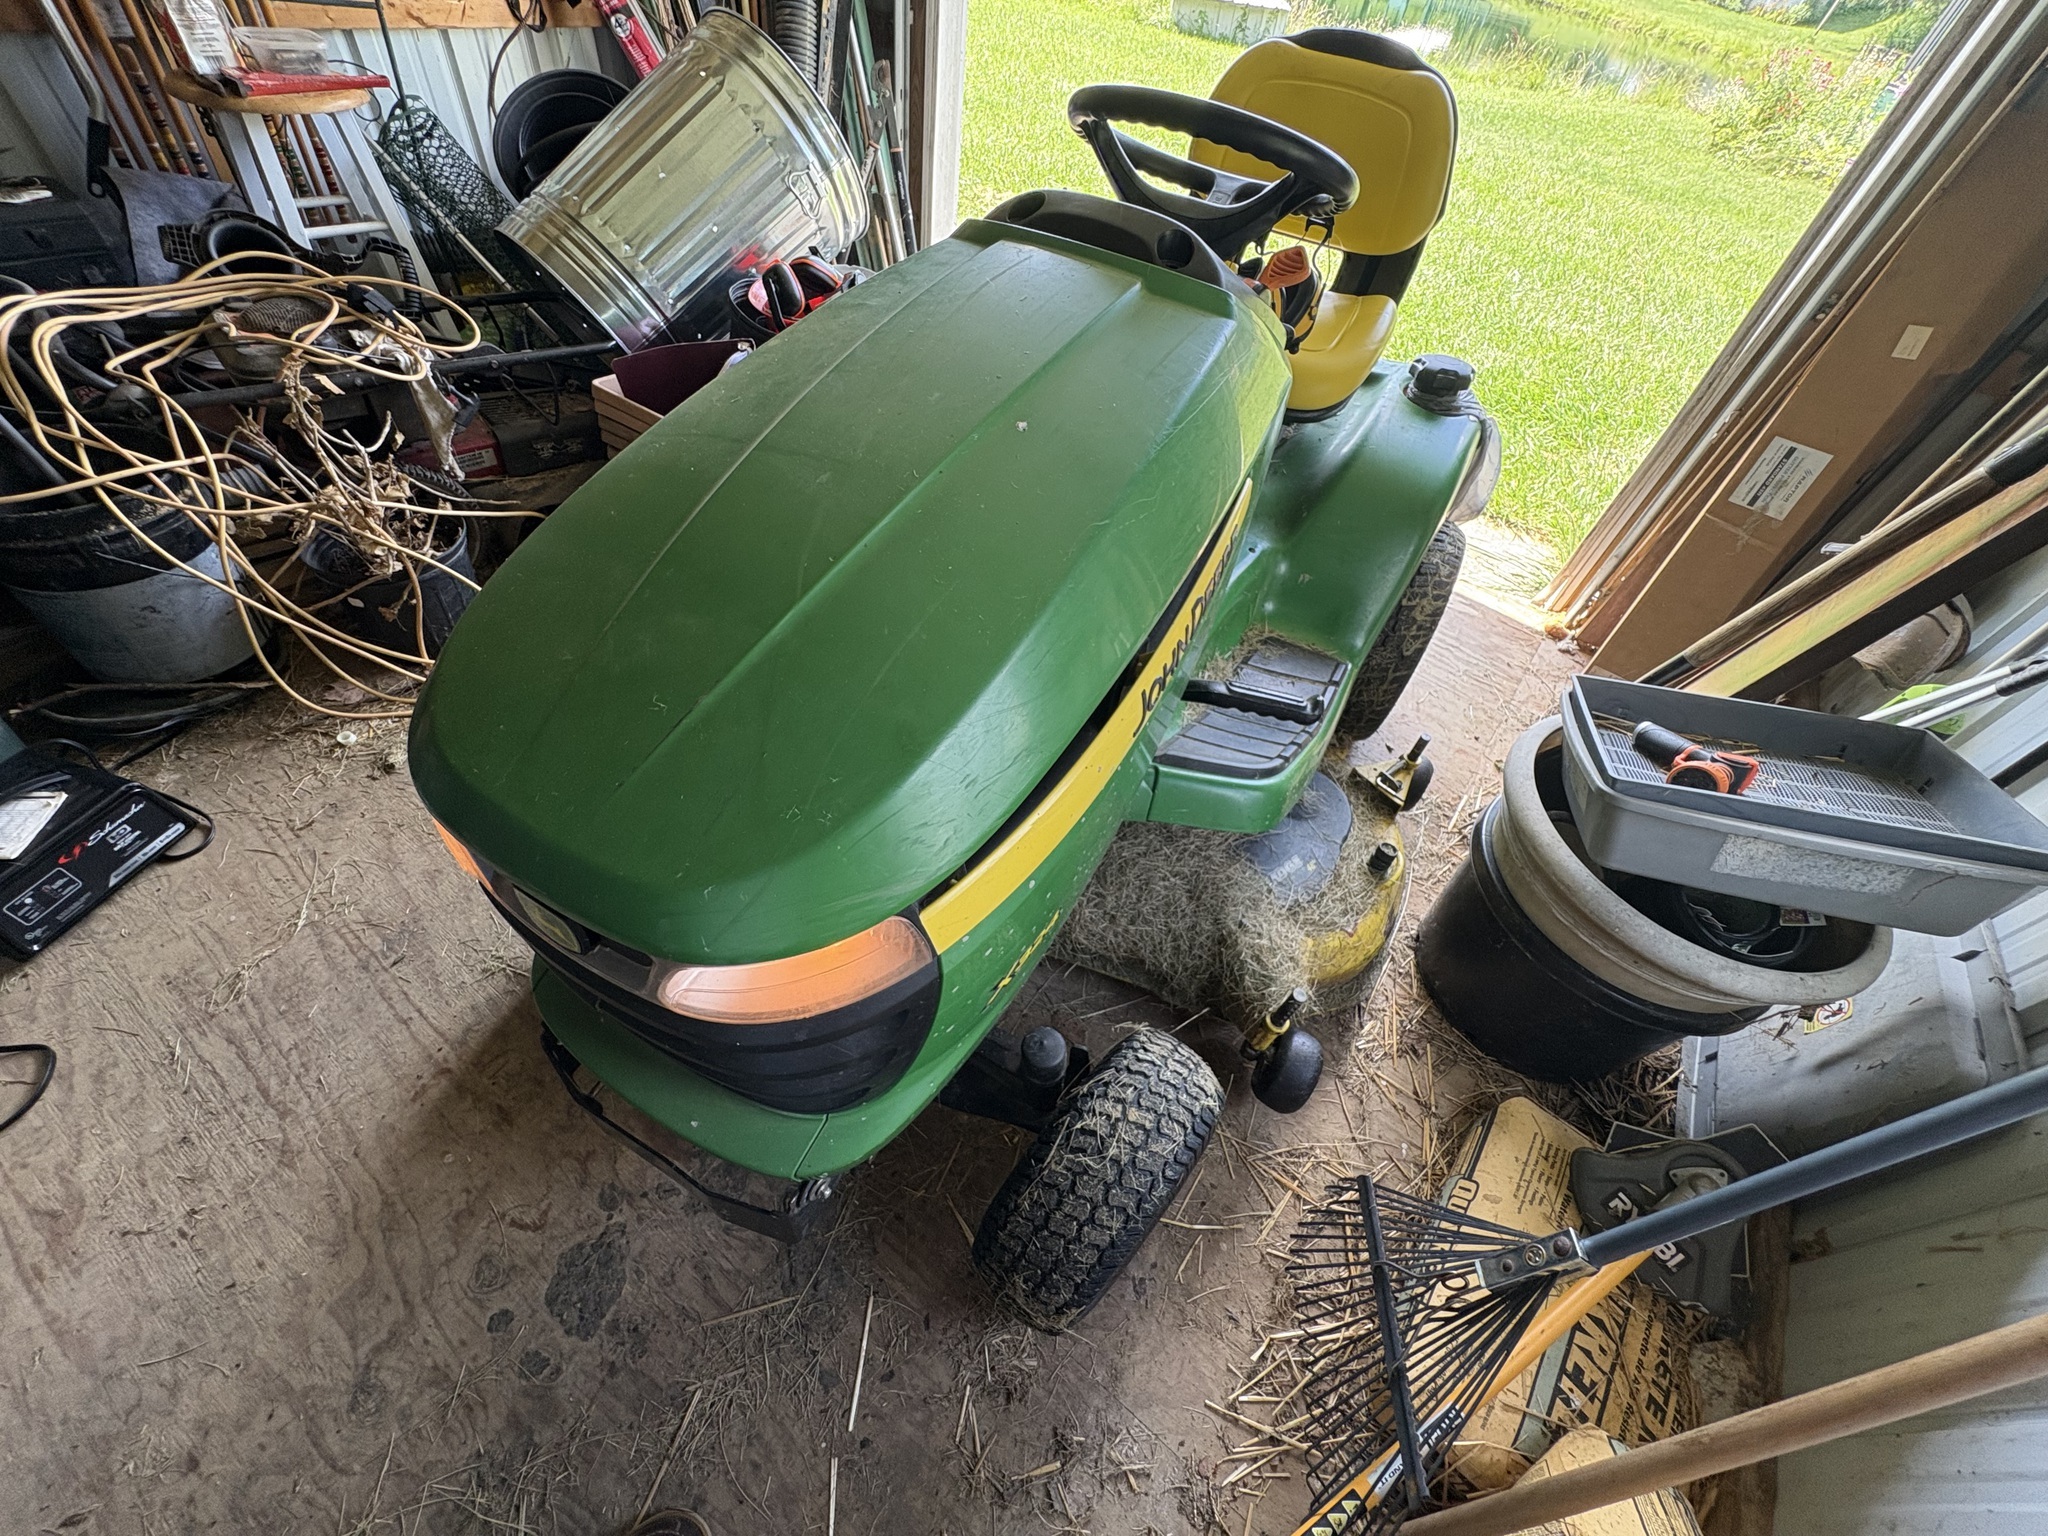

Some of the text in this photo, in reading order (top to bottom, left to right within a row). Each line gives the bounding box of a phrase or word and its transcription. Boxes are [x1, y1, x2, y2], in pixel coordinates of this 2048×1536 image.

[1764, 458, 1788, 486] STANDARD
[1783, 475, 1807, 503] RAPTOR
[1635, 1357, 1646, 1375] de
